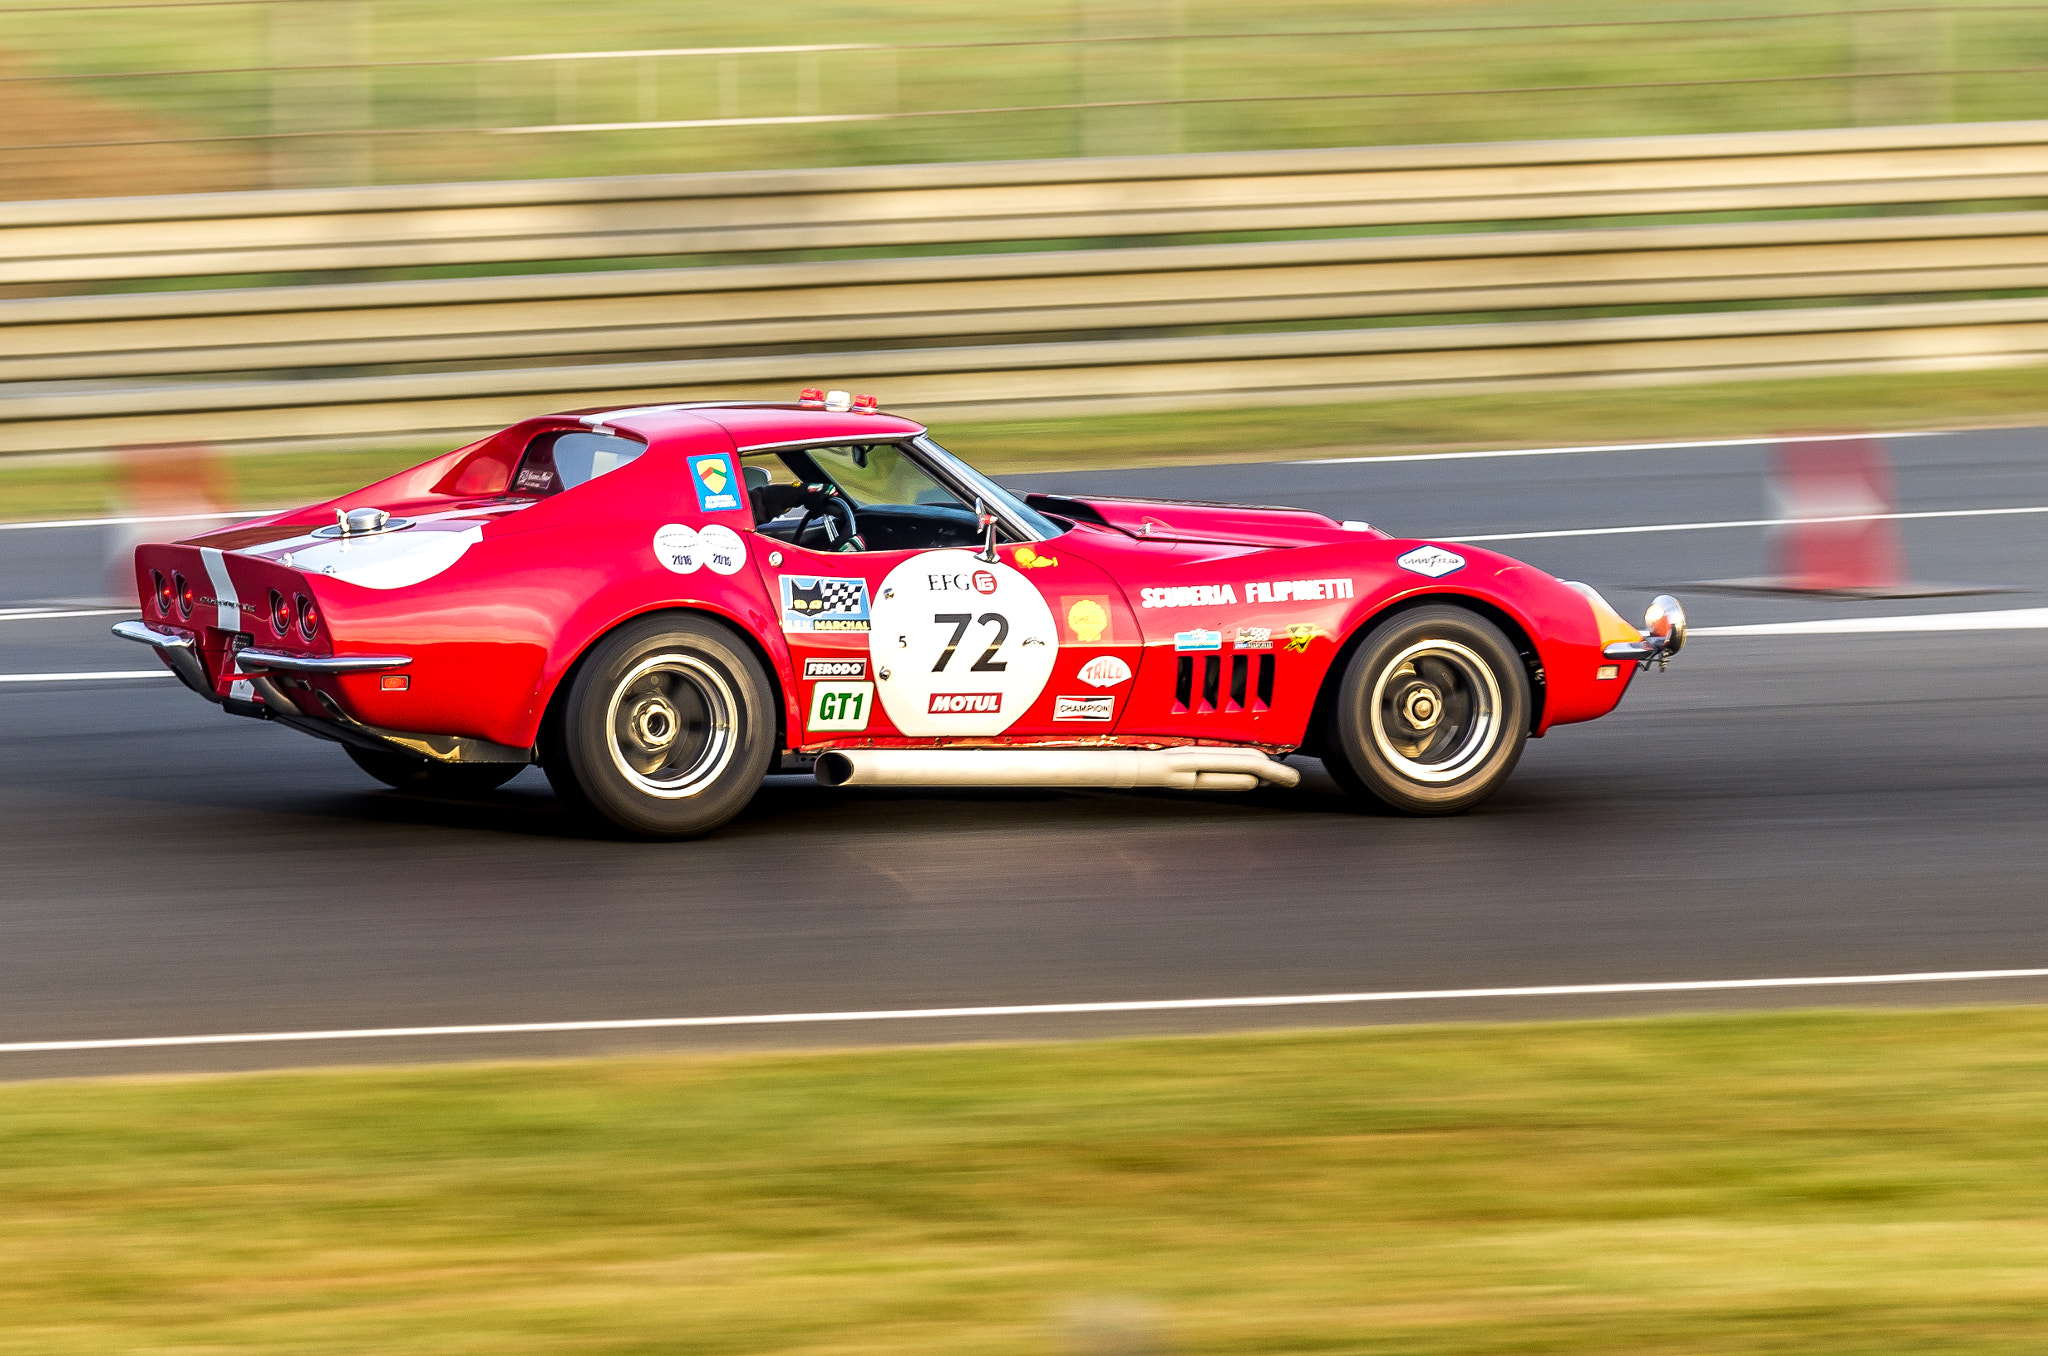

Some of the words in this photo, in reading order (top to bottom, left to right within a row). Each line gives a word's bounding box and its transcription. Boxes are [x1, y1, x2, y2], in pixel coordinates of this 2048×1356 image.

[671, 554, 693, 566] 2016
[927, 574, 970, 591] EFG
[1140, 583, 1238, 608] SCUDERIA
[814, 619, 870, 630] MARCHAL
[898, 635, 908, 649] 5
[931, 612, 1010, 673] 72
[807, 662, 862, 675] FERODO
[819, 692, 864, 721] GT1
[930, 695, 1000, 712] MOTUL
[1060, 704, 1111, 713] CHAMPION
